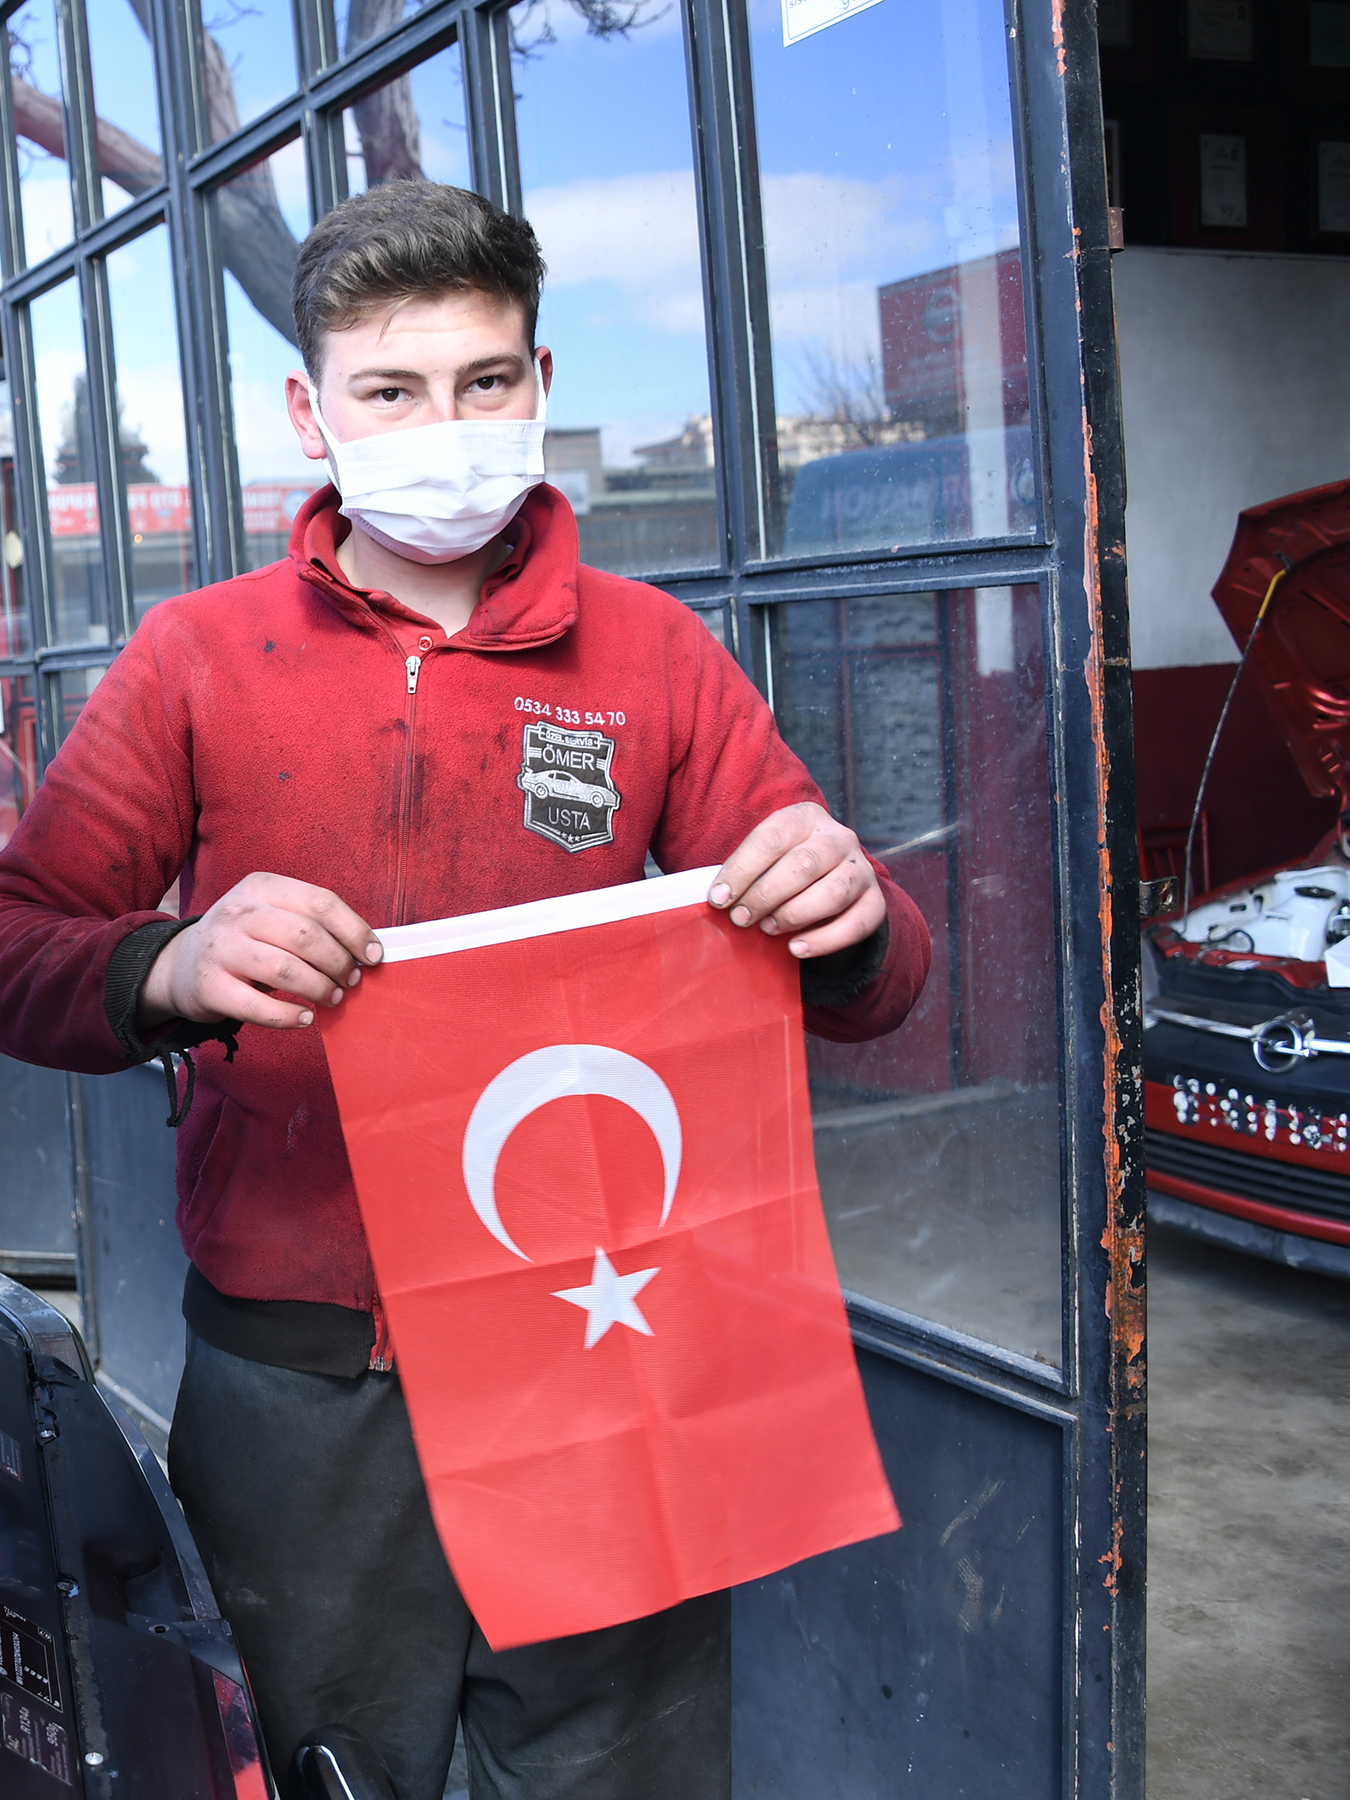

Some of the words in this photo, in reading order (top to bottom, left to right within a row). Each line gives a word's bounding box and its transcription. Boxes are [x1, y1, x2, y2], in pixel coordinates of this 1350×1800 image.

[514, 697, 552, 716] 0534
[555, 707, 581, 725] 333
[585, 712, 606, 726] 54
[606, 711, 626, 726] 70
[542, 744, 596, 771] ÖMER
[548, 807, 591, 831] USTA
[7, 1734, 20, 1752] AC
